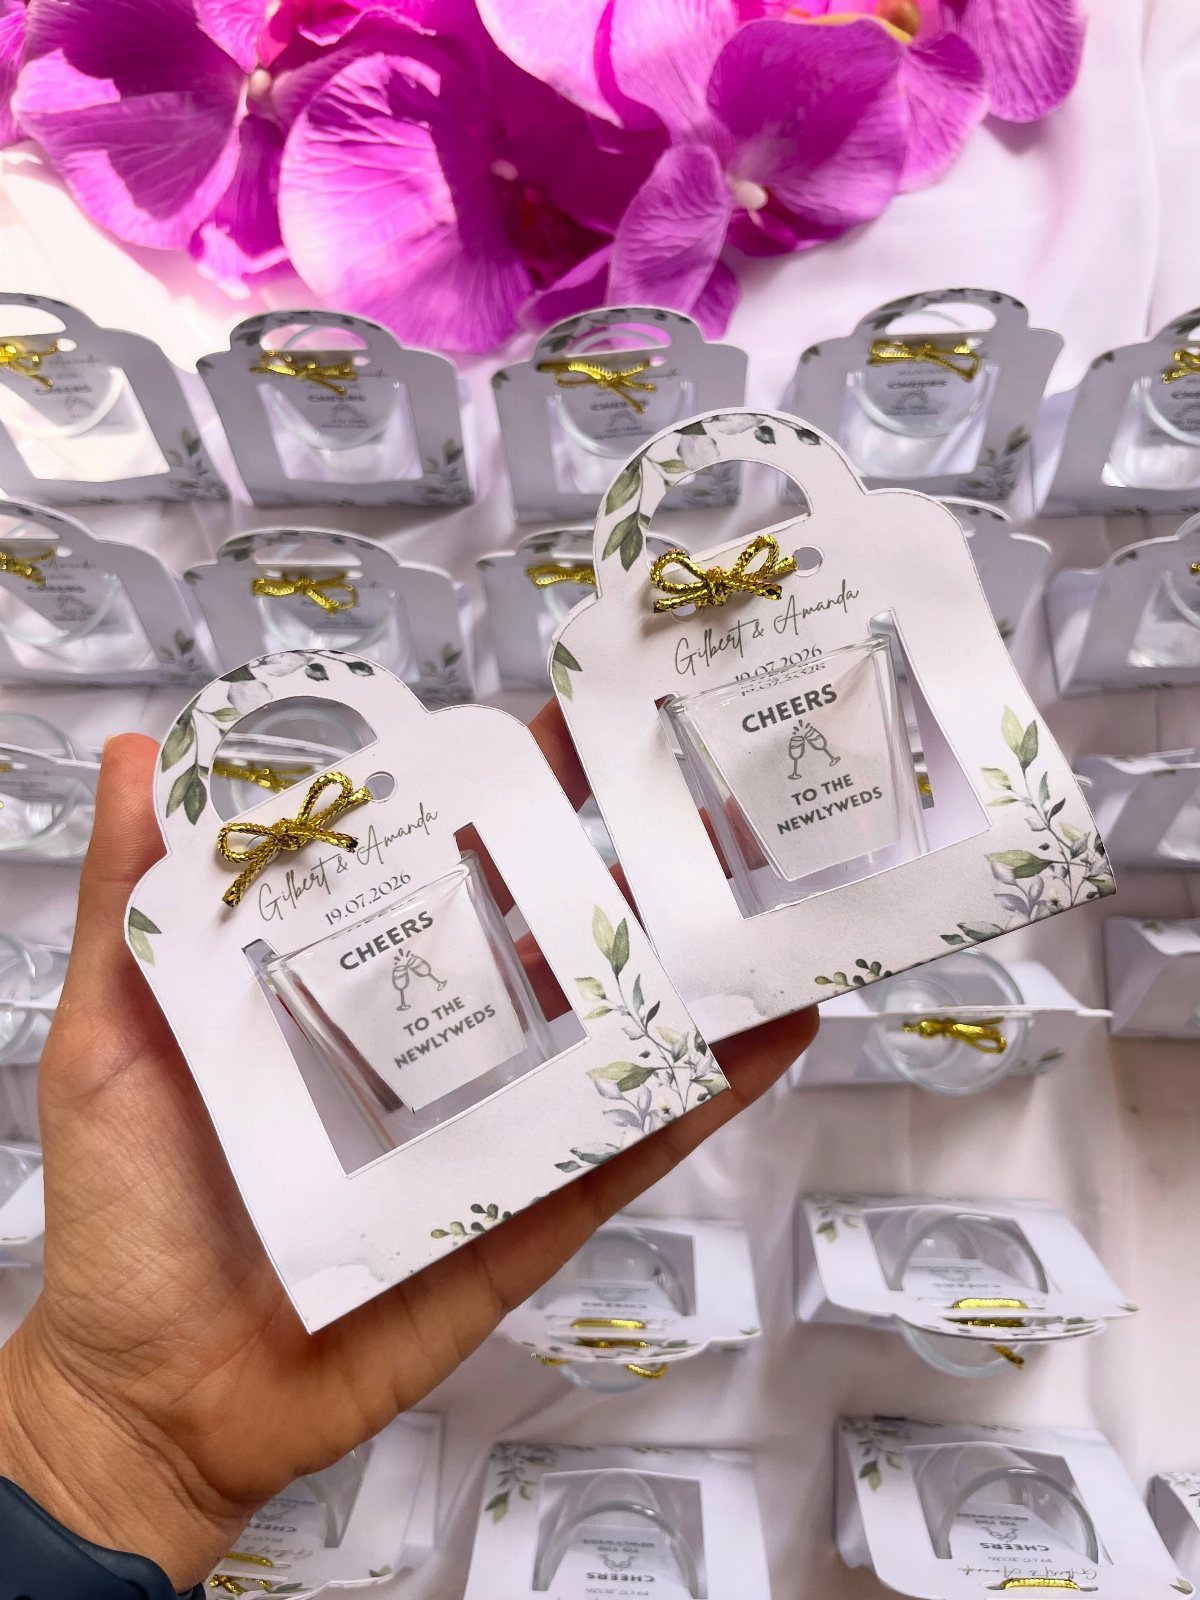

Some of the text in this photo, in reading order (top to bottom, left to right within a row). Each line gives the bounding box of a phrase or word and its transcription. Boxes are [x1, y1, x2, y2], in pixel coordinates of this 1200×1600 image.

[675, 579, 859, 676] Gilbert & Amanda
[741, 683, 838, 734] CHEERS
[776, 786, 883, 836] NEWLYWEDS
[791, 774, 854, 807] TO THE
[258, 802, 438, 922] Gilbert & Amanda
[324, 870, 412, 926] 19.07.2026
[339, 910, 434, 971] CHEERS
[393, 1003, 497, 1070] NEWLYWEDS
[403, 996, 466, 1037] TO THE
[979, 1543, 1049, 1552] CHEERS
[586, 1573, 655, 1582] CHEERS
